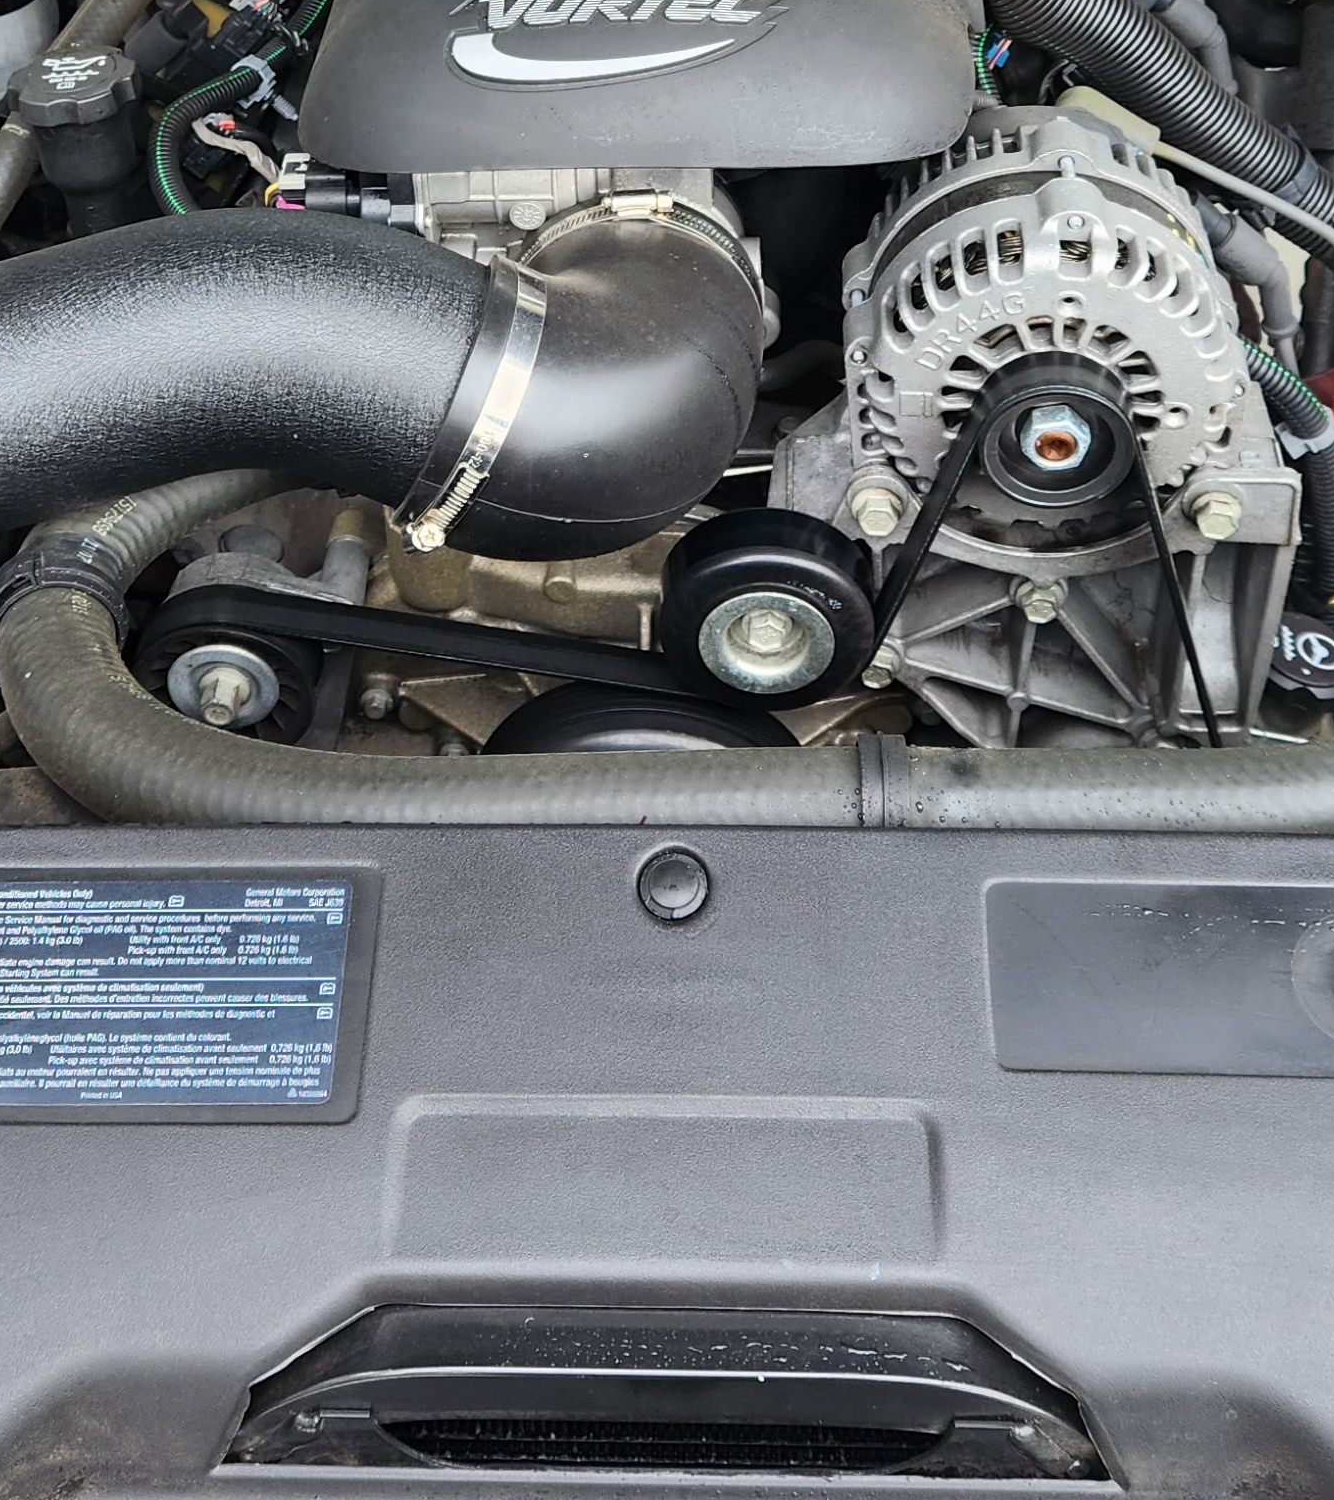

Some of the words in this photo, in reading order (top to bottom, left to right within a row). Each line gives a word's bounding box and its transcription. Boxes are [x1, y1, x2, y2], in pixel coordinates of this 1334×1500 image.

[914, 290, 1026, 371] DR44G
[39, 890, 71, 898] Vehicles
[72, 890, 93, 899] Only)
[245, 888, 274, 896] General
[275, 888, 301, 896] Motors
[302, 888, 344, 897] Corporation
[6, 900, 34, 908] service
[34, 900, 67, 908] methods
[108, 900, 141, 909] personal
[142, 900, 166, 909] injury.
[4, 914, 33, 923] Service
[33, 914, 62, 923] Manual
[62, 914, 74, 923] for
[74, 914, 113, 924] diagnostic
[114, 914, 129, 923] and
[130, 914, 157, 923] service
[158, 914, 201, 924] procedures
[203, 914, 228, 923] before
[228, 914, 270, 924] performing
[286, 914, 316, 922] service.
[31, 935, 44, 943] 1.4
[56, 935, 71, 945] (3.0
[129, 935, 151, 944] Utility
[152, 935, 169, 943] with
[170, 935, 189, 943] front
[189, 935, 204, 944] A/C
[204, 935, 222, 944] only
[108, 982, 159, 991] climatisation
[160, 982, 204, 992] seulement)
[49, 1043, 87, 1052] Utilitaires
[107, 1044, 140, 1054] système
[152, 1043, 202, 1052] climatisation
[203, 1044, 225, 1052] avant
[226, 1043, 267, 1052] seulement
